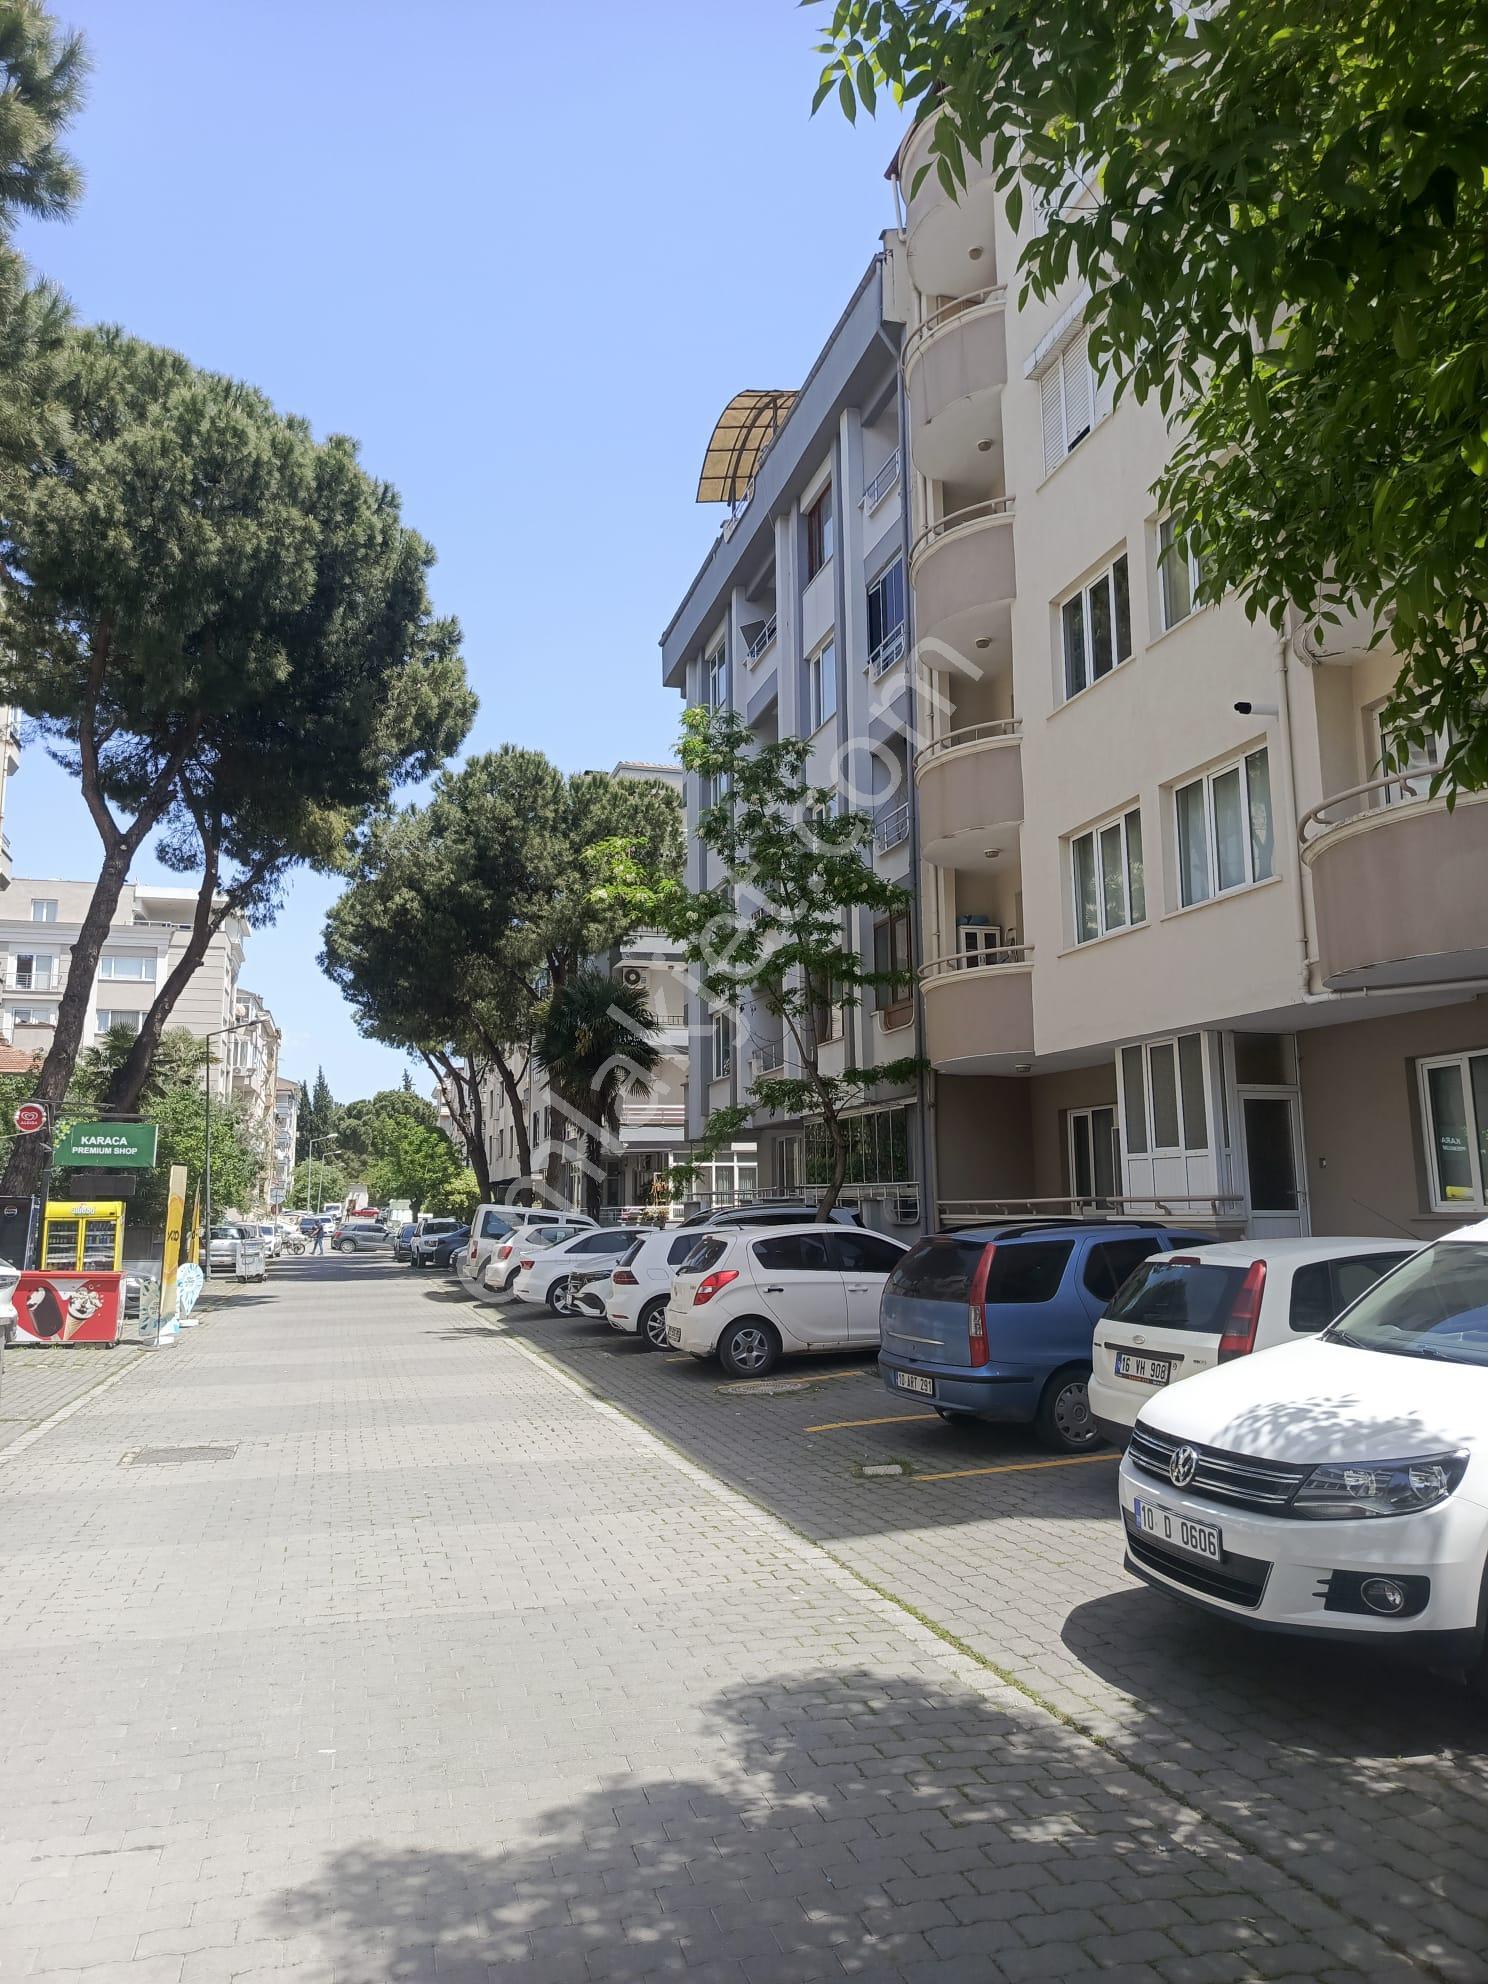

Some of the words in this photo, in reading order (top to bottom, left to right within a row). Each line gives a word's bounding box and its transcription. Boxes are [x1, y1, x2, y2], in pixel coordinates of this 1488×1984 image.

[81, 1136, 128, 1146] KARACA
[71, 1146, 112, 1154] PREMIUM
[114, 1147, 138, 1155] SHOP
[1122, 1356, 1130, 1373] 16
[1136, 1360, 1146, 1376] VH
[1150, 1363, 1166, 1380] 908
[1142, 1505, 1154, 1530] 10
[1164, 1515, 1172, 1538] D
[1181, 1521, 1216, 1556] 0606
